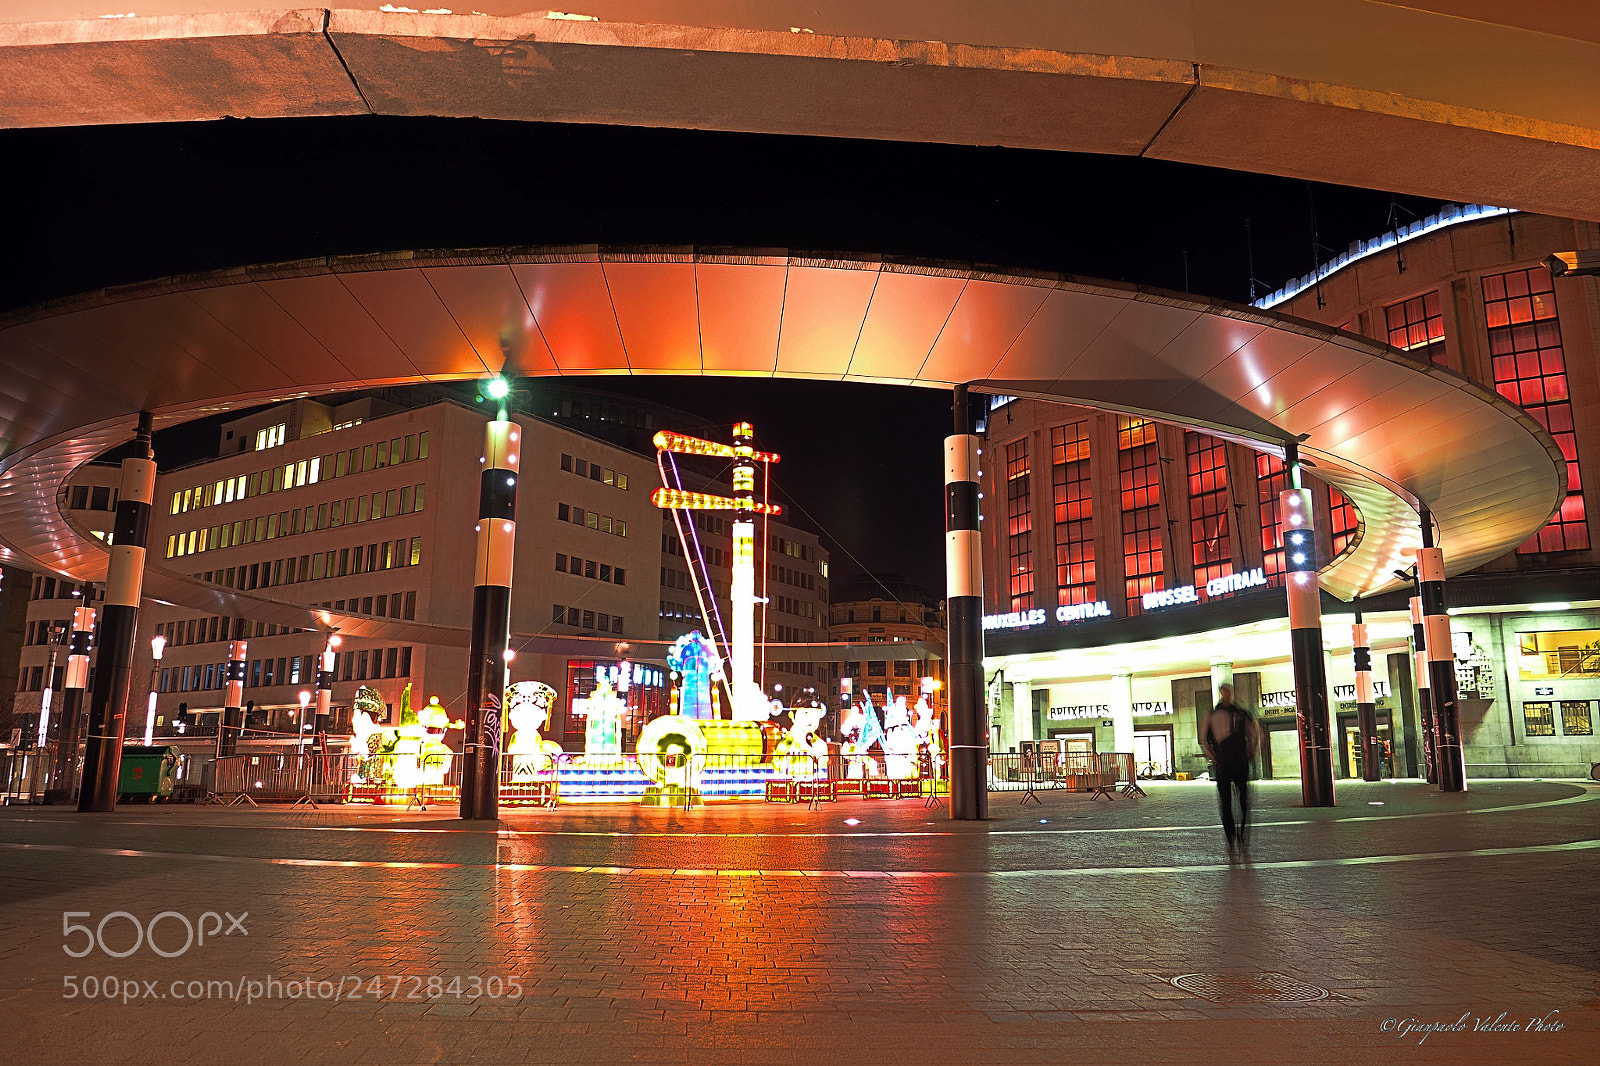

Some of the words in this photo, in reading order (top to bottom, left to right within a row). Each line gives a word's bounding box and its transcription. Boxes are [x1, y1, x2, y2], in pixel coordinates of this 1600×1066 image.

[1142, 584, 1199, 610] BRUSSEL
[1206, 567, 1267, 597] CENTRAAL
[1056, 600, 1111, 622] CENTRAL
[1262, 690, 1296, 707] BRUSS
[1050, 704, 1109, 719] BRUXELLES
[1132, 701, 1170, 715] NTRAL
